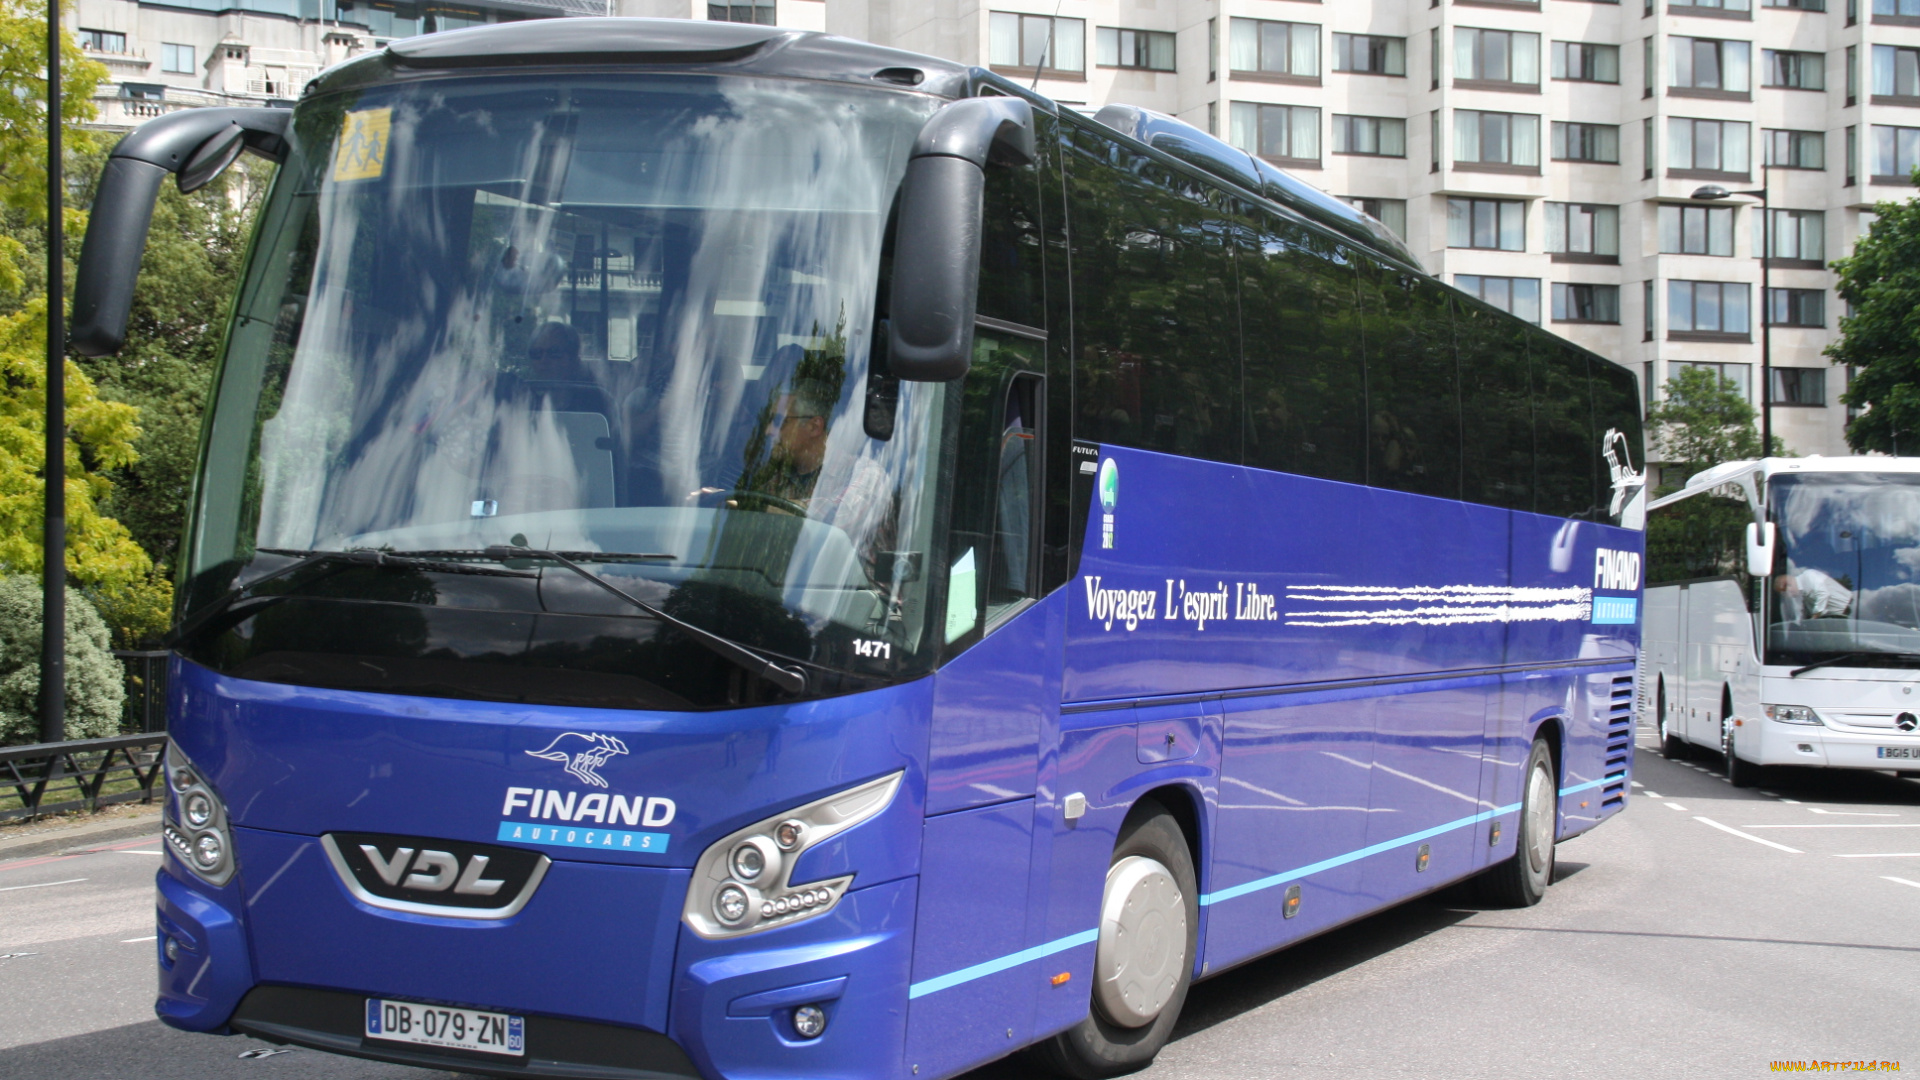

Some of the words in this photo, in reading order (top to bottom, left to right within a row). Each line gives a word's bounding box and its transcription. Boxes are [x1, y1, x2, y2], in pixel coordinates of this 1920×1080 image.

[1594, 547, 1641, 591] FINAND
[1084, 575, 1157, 632] Voyagez
[1164, 579, 1229, 631] L'esprit
[1234, 582, 1278, 621] Libre.
[852, 638, 891, 659] 1471
[502, 786, 677, 828] FINAND
[512, 825, 652, 849] AUTOCARS
[358, 844, 506, 896] VDL
[371, 1020, 378, 1028] F
[384, 1004, 506, 1046] DB-079-ZN
[508, 1034, 522, 1049] 60
